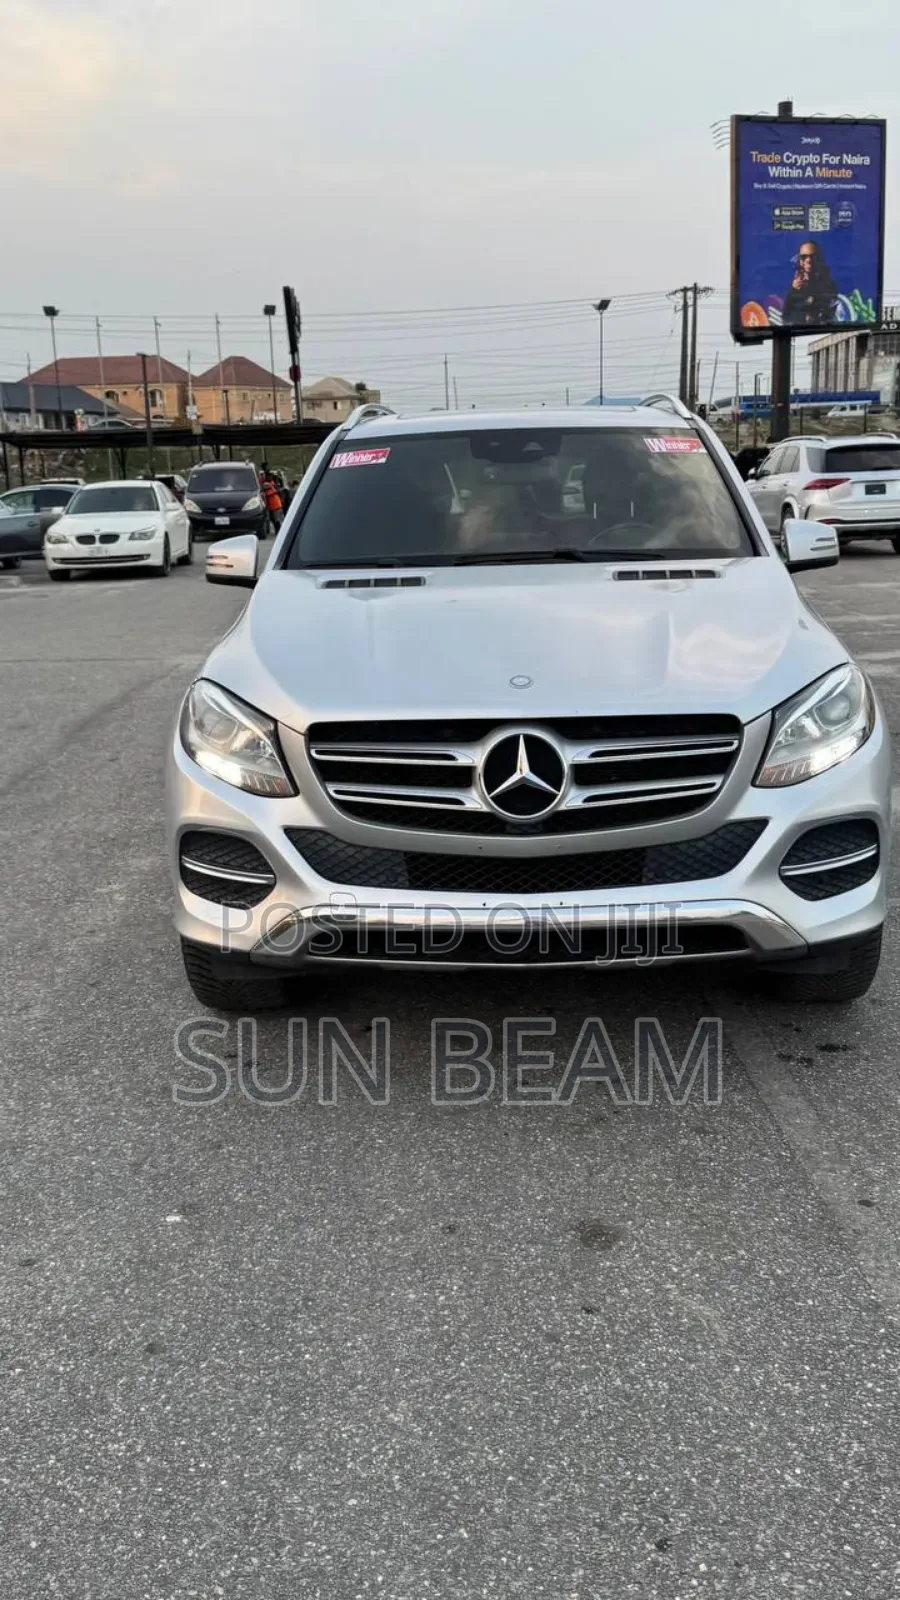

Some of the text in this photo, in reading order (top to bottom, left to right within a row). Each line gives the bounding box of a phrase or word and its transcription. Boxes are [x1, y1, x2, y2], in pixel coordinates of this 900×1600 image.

[750, 151, 870, 166] Trade Crypto For Naira
[768, 166, 853, 178] Within A Minute
